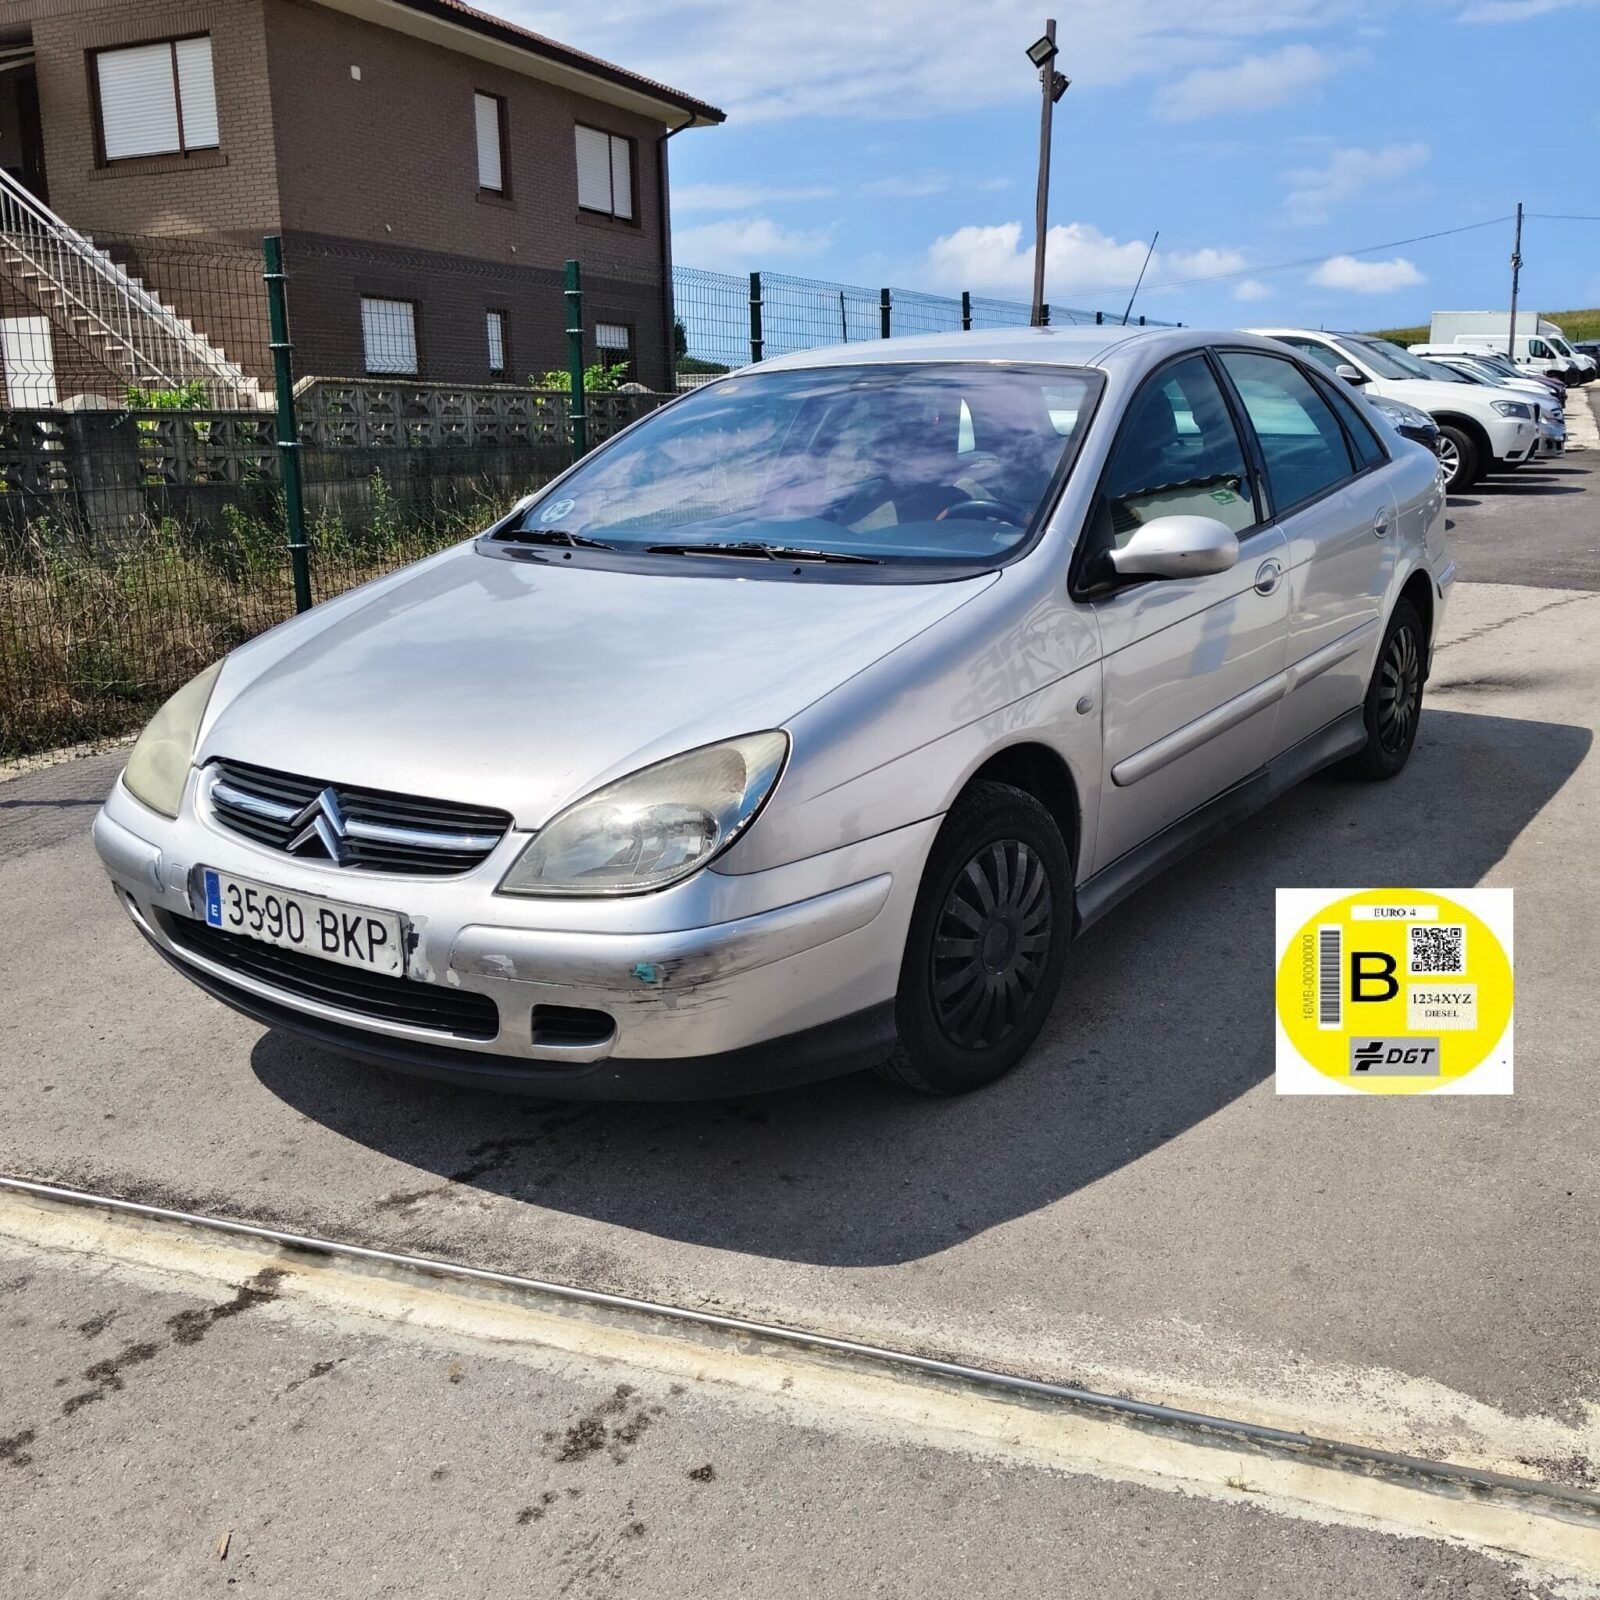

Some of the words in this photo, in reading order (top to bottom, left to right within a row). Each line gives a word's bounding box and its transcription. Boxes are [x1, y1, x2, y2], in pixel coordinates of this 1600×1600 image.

[211, 904, 219, 917] E
[227, 884, 304, 943] 3590
[319, 908, 388, 963] BKP
